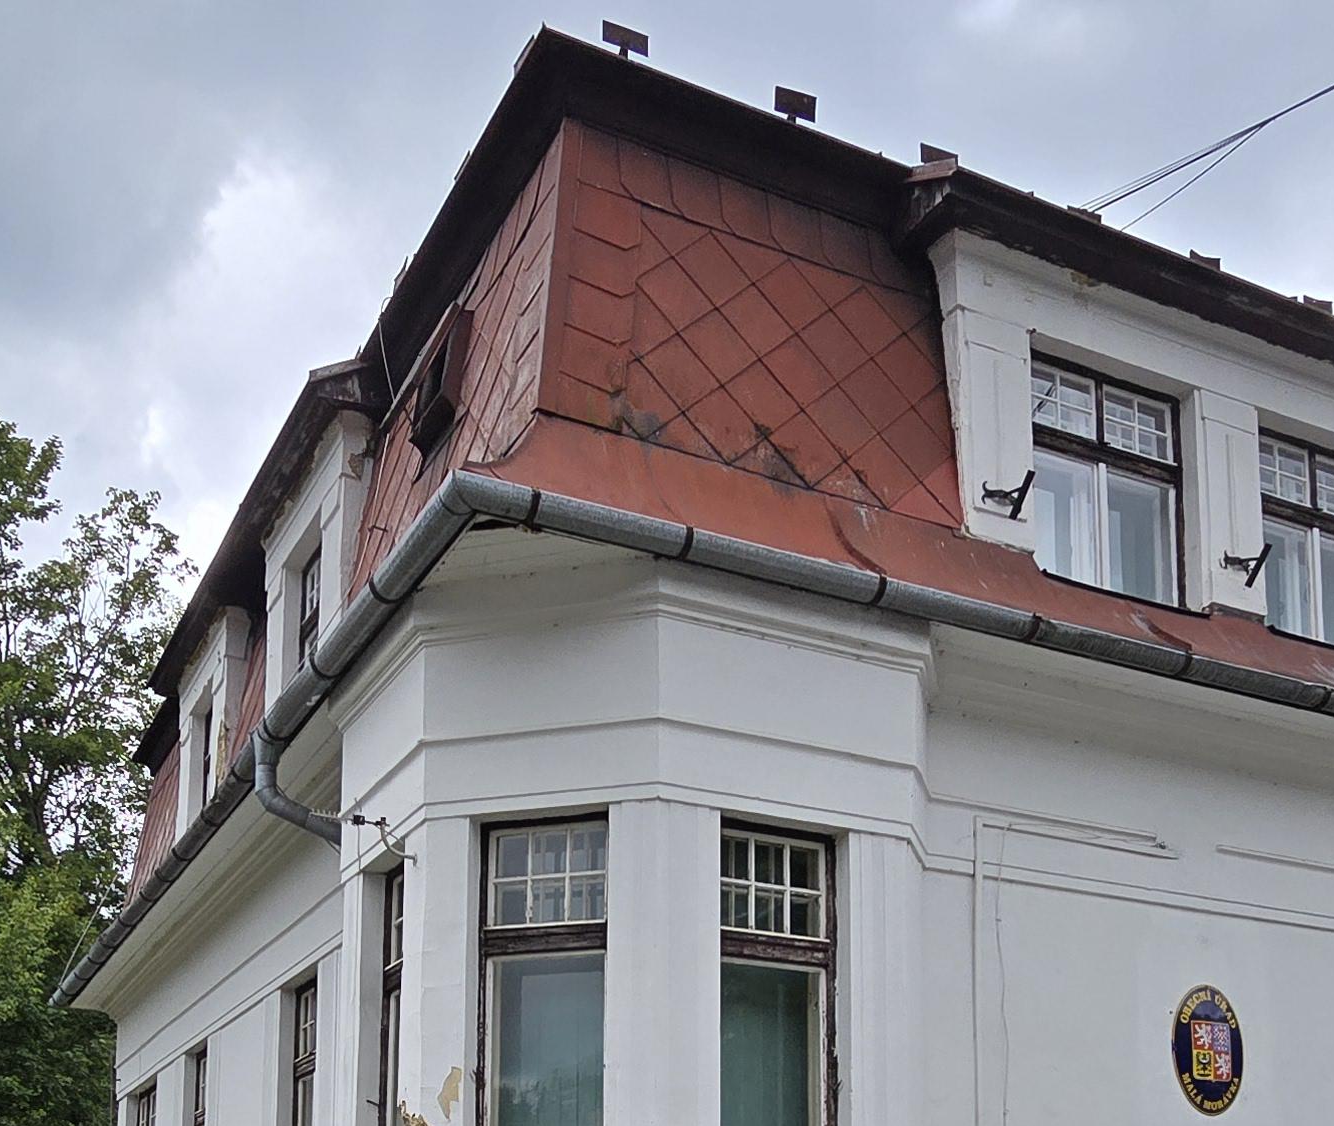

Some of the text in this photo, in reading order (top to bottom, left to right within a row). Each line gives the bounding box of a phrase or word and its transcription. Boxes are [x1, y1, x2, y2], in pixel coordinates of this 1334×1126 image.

[1180, 989, 1211, 1024] OBECNÍ
[1181, 1072, 1239, 1111] MALÁ MORÁVKA
